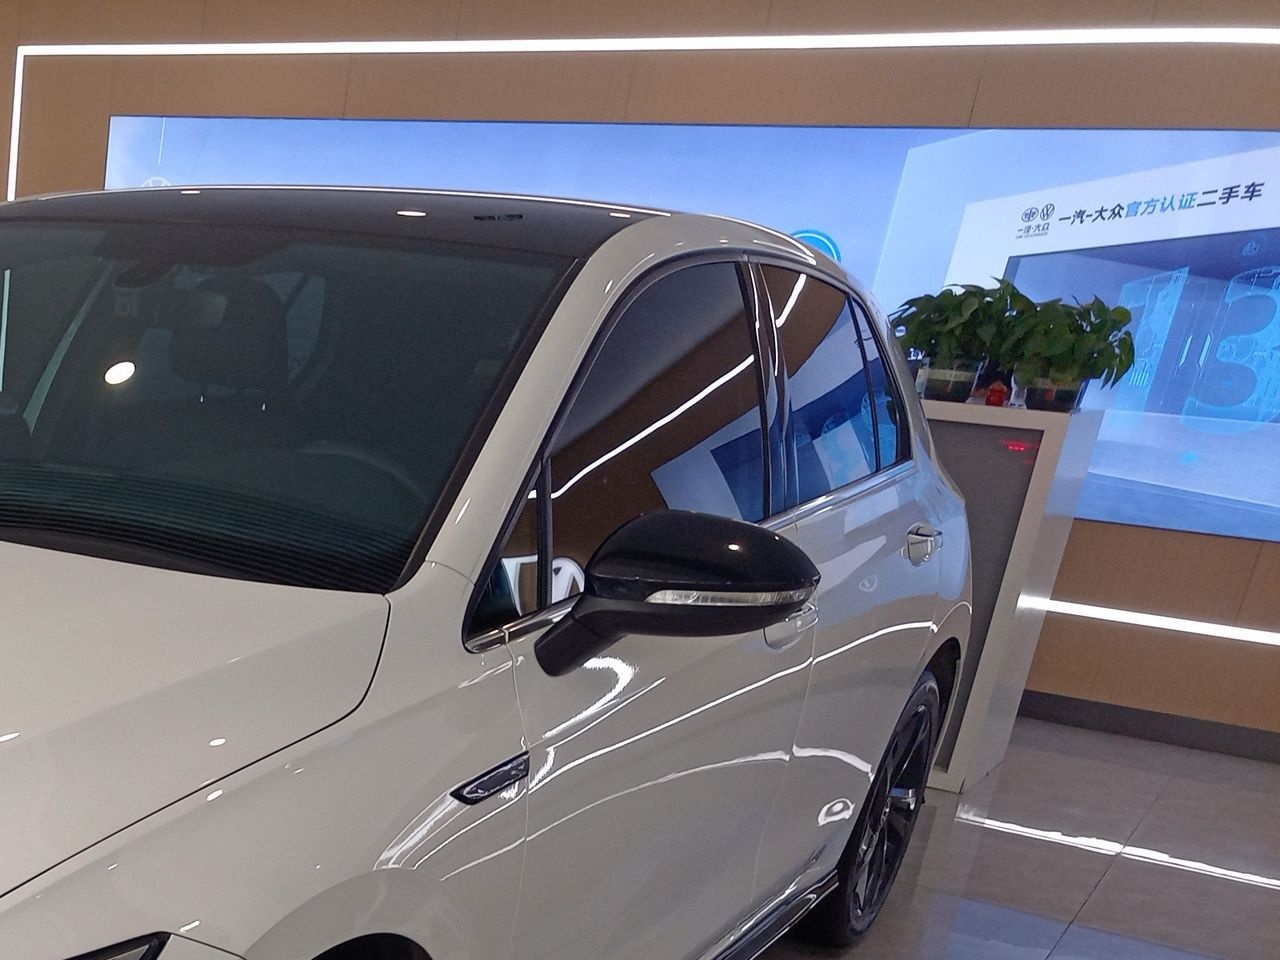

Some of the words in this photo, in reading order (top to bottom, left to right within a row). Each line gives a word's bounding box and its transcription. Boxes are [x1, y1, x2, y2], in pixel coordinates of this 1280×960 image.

[1058, 181, 1265, 226] 一汽-大众官方认证二手车
